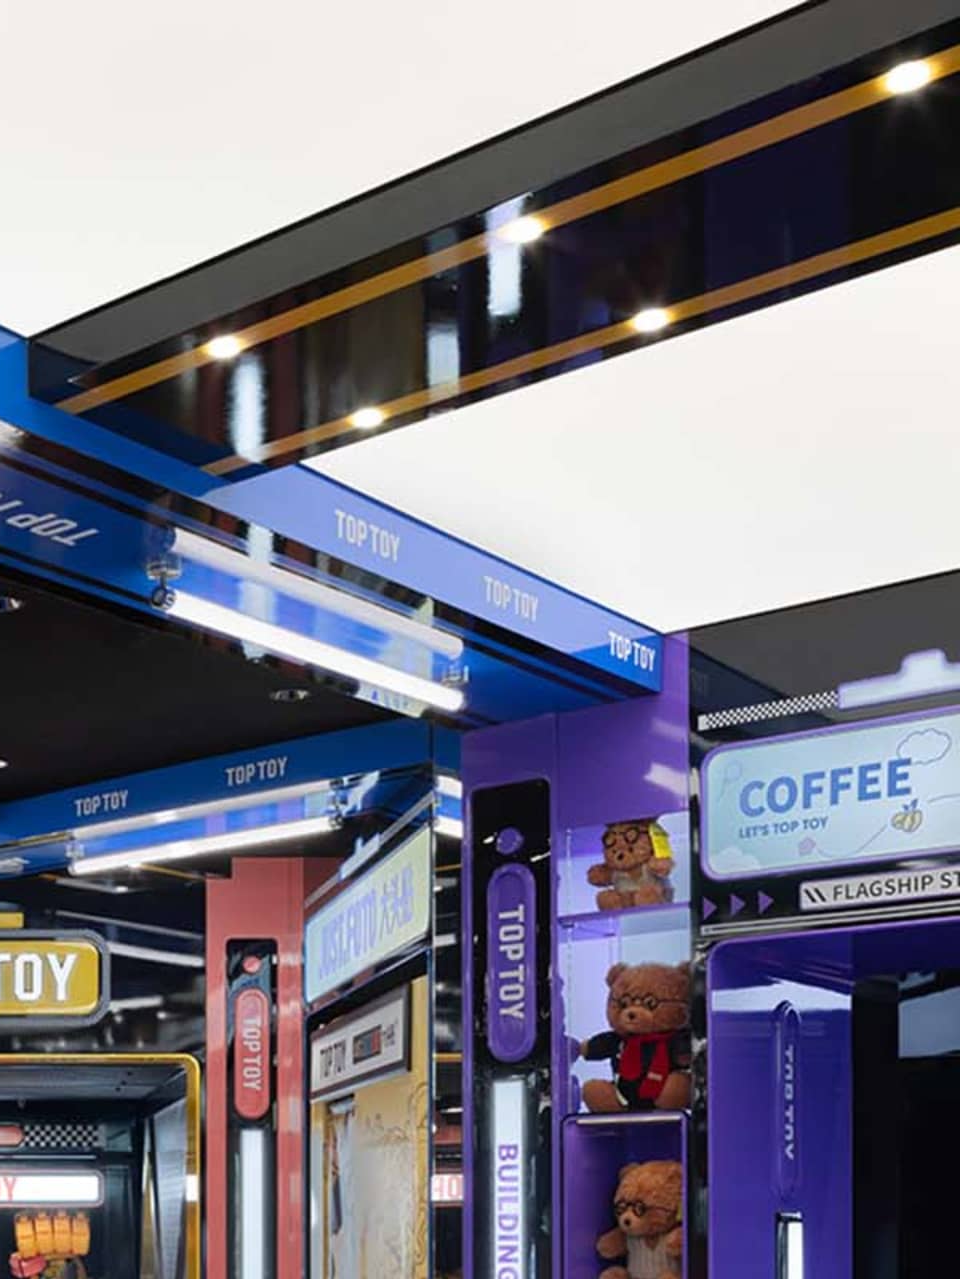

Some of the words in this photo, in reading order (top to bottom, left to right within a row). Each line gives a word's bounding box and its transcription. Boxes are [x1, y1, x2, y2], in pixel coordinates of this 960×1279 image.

[6, 512, 99, 546] TOP
[335, 509, 367, 547] TOP
[368, 524, 400, 563] TOY
[484, 575, 512, 607] TOP
[512, 589, 539, 622] TOY
[608, 631, 632, 661] TOP
[632, 641, 657, 672] TOY
[225, 764, 255, 785] TOP
[256, 756, 288, 781] TOY
[740, 757, 912, 818] COFFEE
[74, 797, 102, 818] TOP
[102, 789, 129, 811] TOY
[739, 822, 770, 840] LET'S
[773, 819, 800, 835] TOP
[803, 816, 829, 831] TOY
[832, 875, 935, 902] FLAGSHIP
[499, 903, 526, 962] TOP
[499, 963, 526, 1022] TOY
[243, 1017, 261, 1052] TOP
[243, 1055, 262, 1091] TOY
